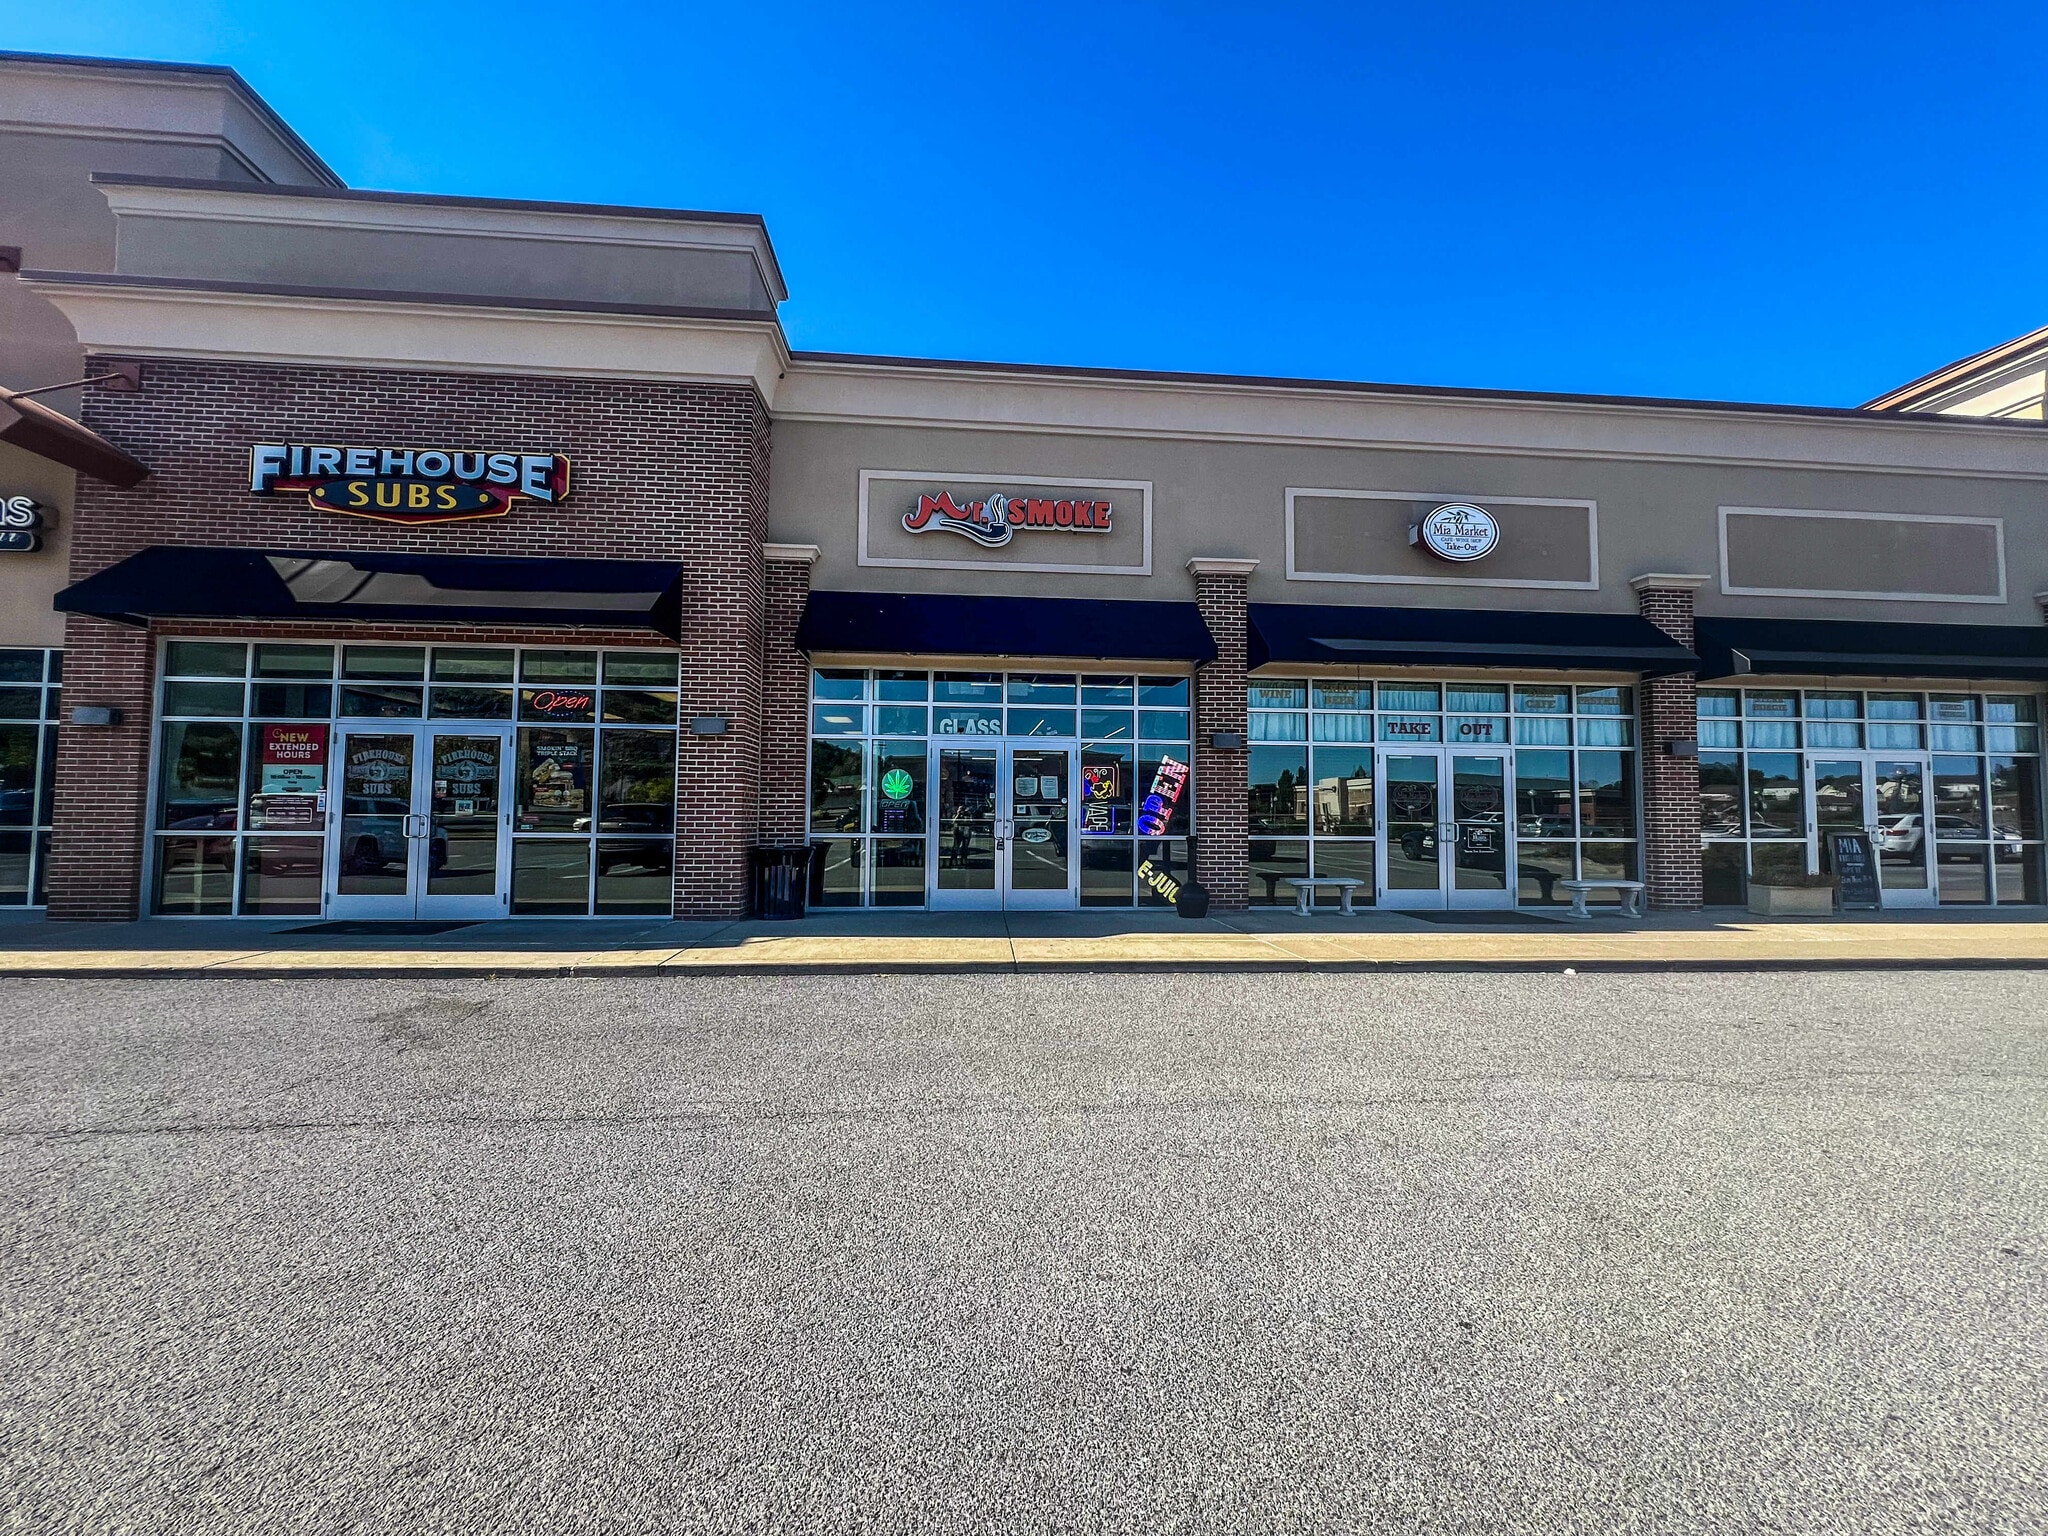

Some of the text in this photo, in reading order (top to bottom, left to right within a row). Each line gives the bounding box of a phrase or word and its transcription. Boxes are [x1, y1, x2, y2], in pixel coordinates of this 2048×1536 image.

[250, 443, 553, 503] FIREHOUSE
[347, 480, 458, 510] SUBS
[904, 490, 1111, 529] Mr. SMOKE
[1433, 523, 1489, 536] Mia Market
[1445, 542, 1478, 551] Take-Out
[533, 691, 590, 711] Open
[1258, 689, 1292, 699] WINE
[939, 718, 1001, 735] GLASS
[1387, 722, 1493, 736] TAKE OUT
[280, 732, 309, 743] NEW
[269, 742, 319, 751] EXTENDED
[276, 751, 311, 759] HOURS
[352, 749, 406, 764] FIREHOUSE
[441, 749, 495, 764] FIREHOUSE
[362, 783, 393, 794] SUBS
[452, 783, 481, 794] SUBS
[1137, 754, 1190, 836] OPEN
[1838, 838, 1862, 854] MIA
[1137, 859, 1181, 904] E-JUIC
